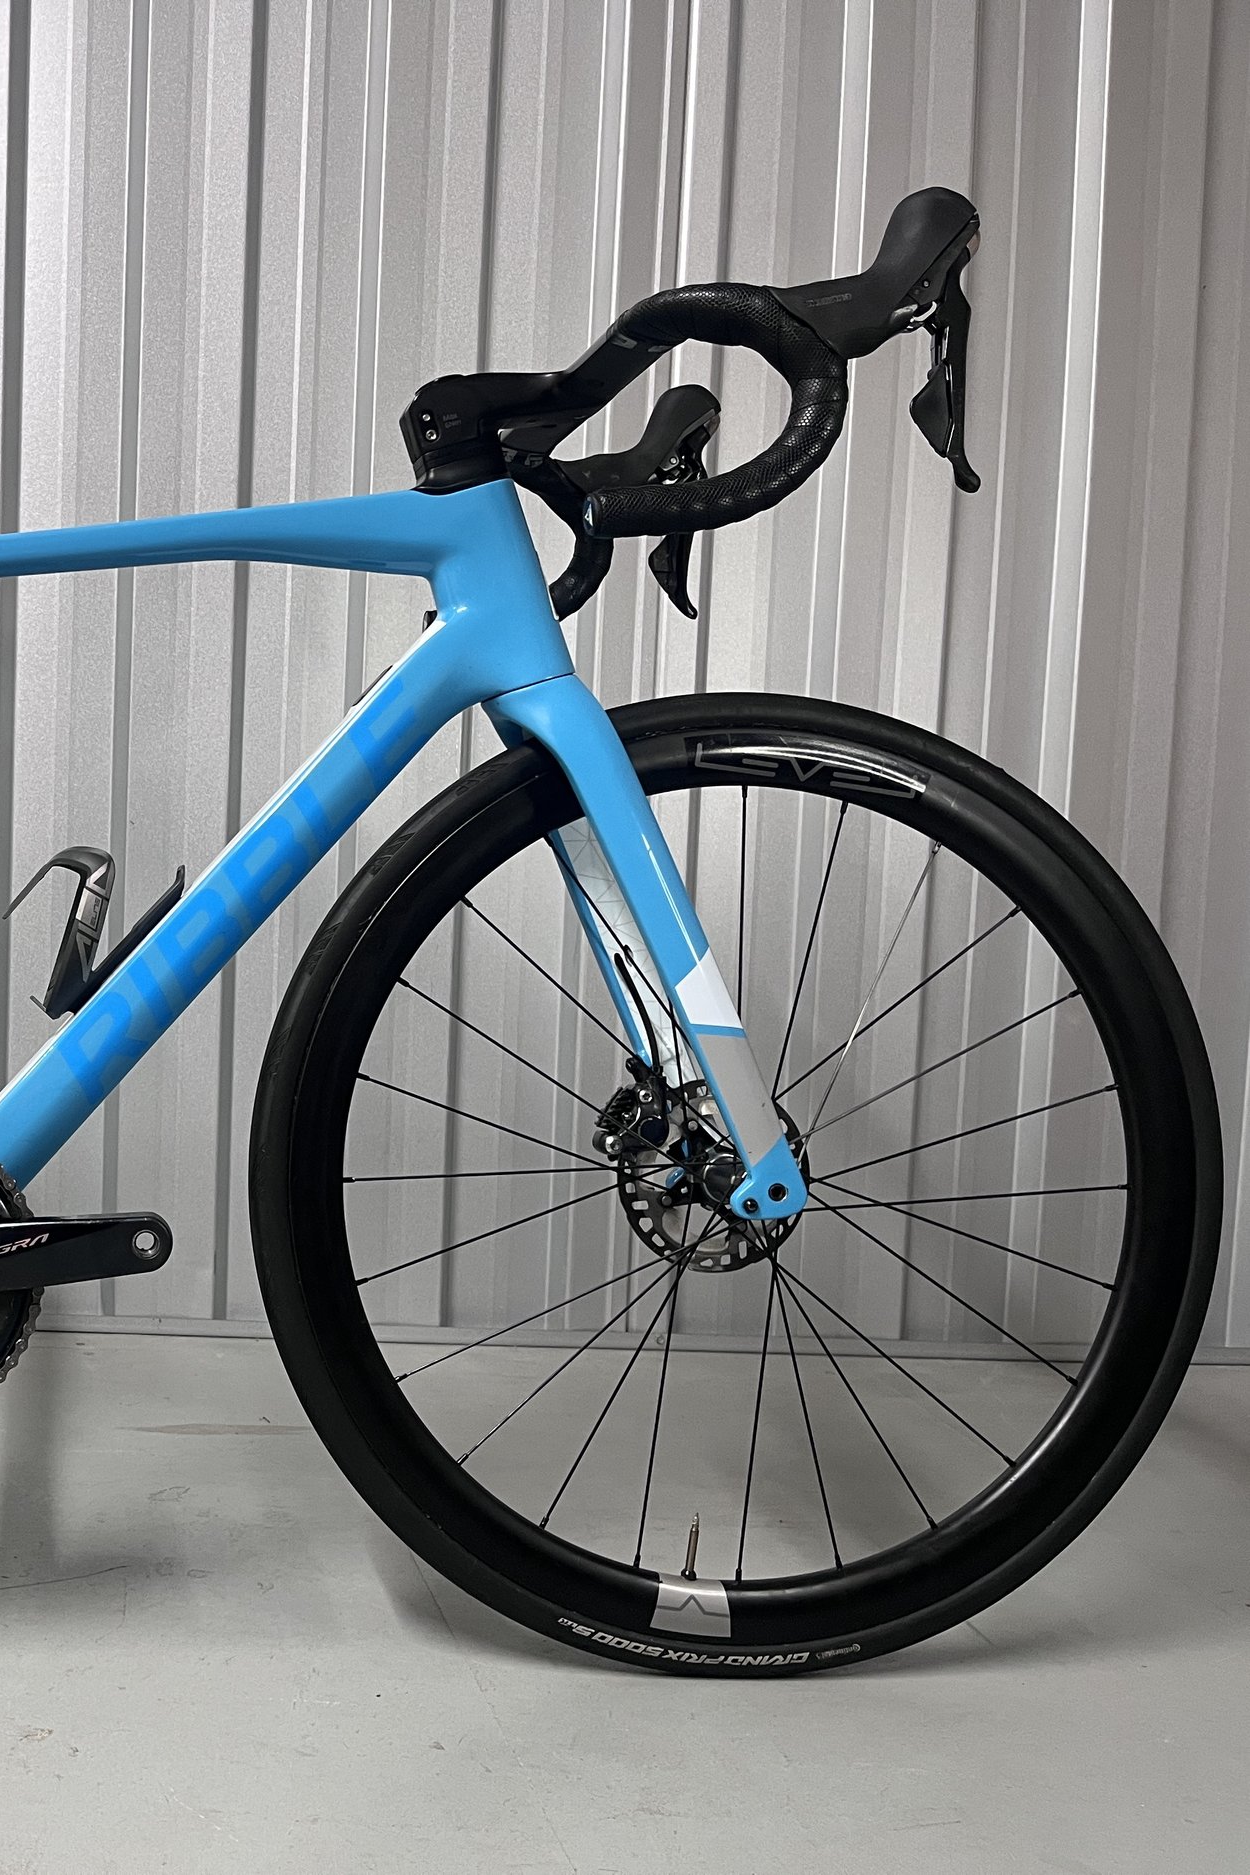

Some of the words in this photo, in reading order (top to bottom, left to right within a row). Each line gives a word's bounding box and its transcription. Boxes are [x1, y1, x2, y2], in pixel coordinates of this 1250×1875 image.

[54, 676, 422, 1104] RIBBLE
[591, 1631, 664, 1657] 5000
[661, 1649, 725, 1664] PRIX
[723, 1652, 811, 1666] GRAND
